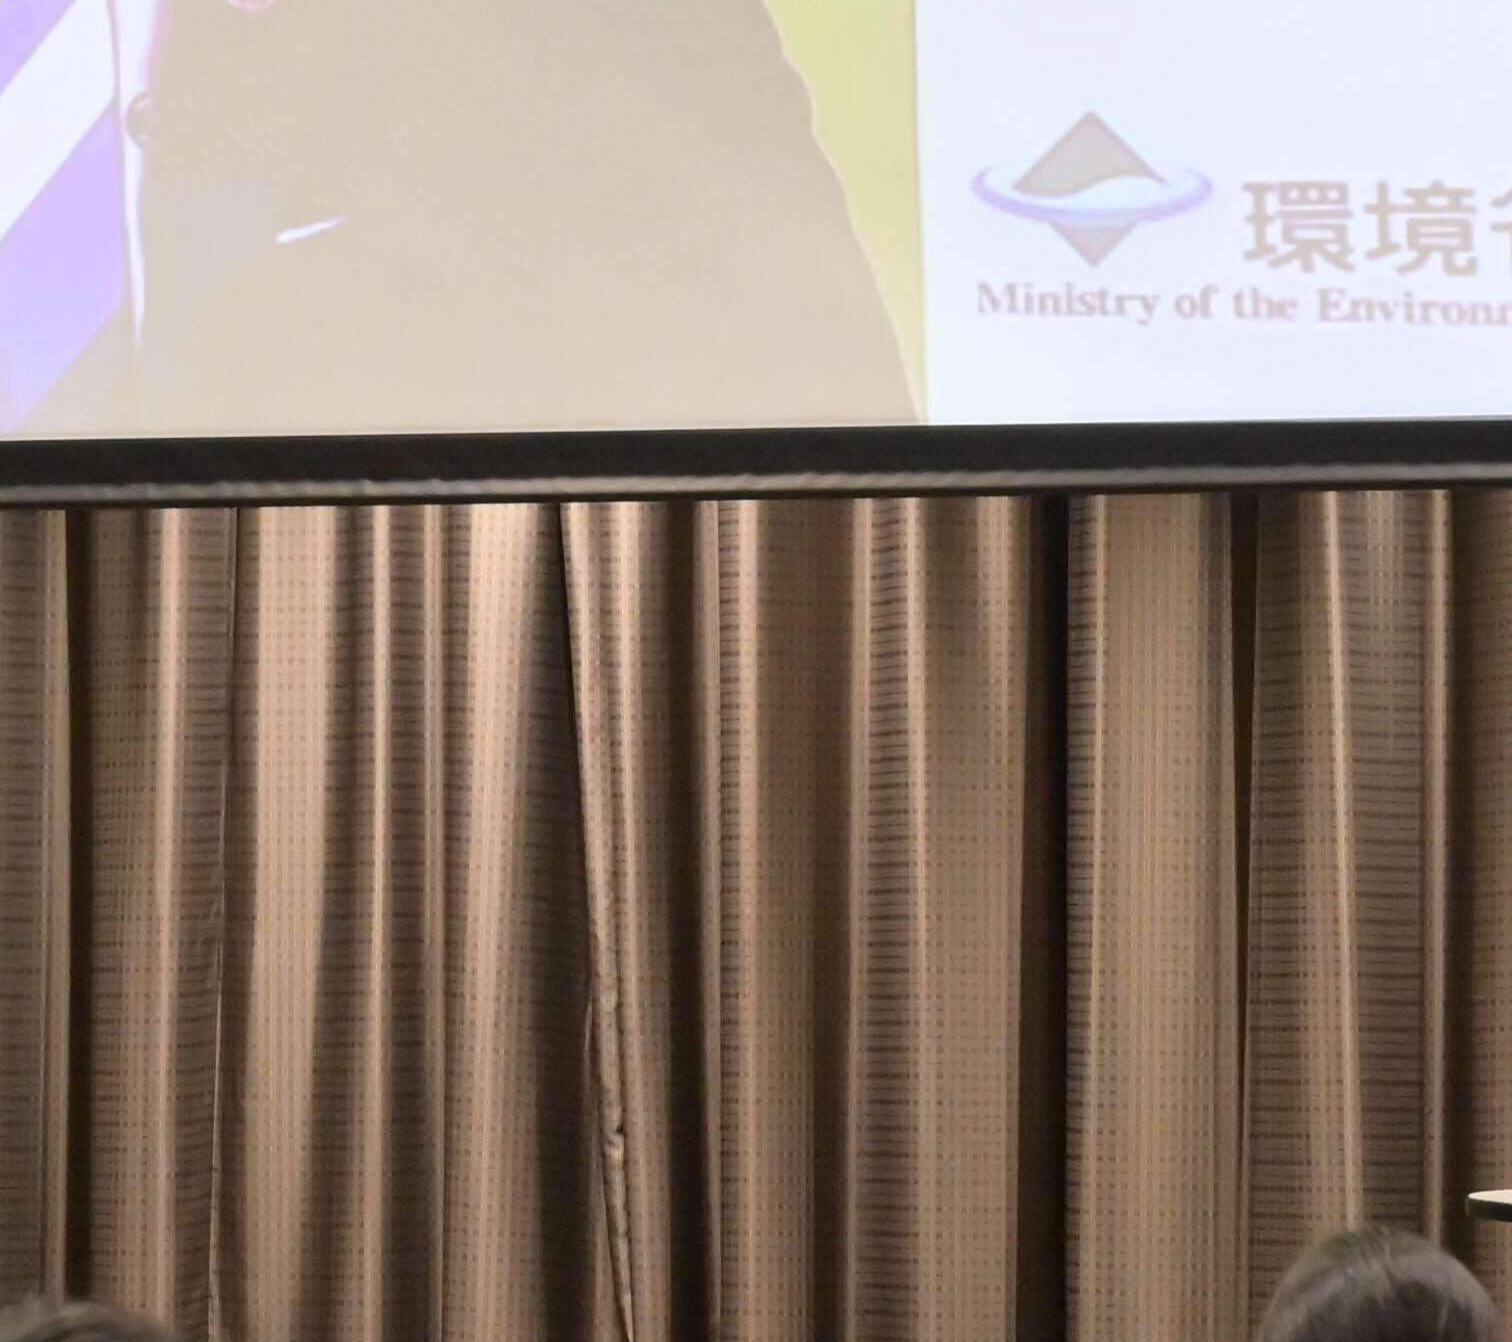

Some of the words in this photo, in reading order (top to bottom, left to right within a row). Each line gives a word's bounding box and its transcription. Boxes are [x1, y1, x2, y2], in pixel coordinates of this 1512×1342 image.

[976, 281, 1159, 325] Ministry
[1175, 284, 1219, 320] of
[1233, 285, 1297, 321] the
